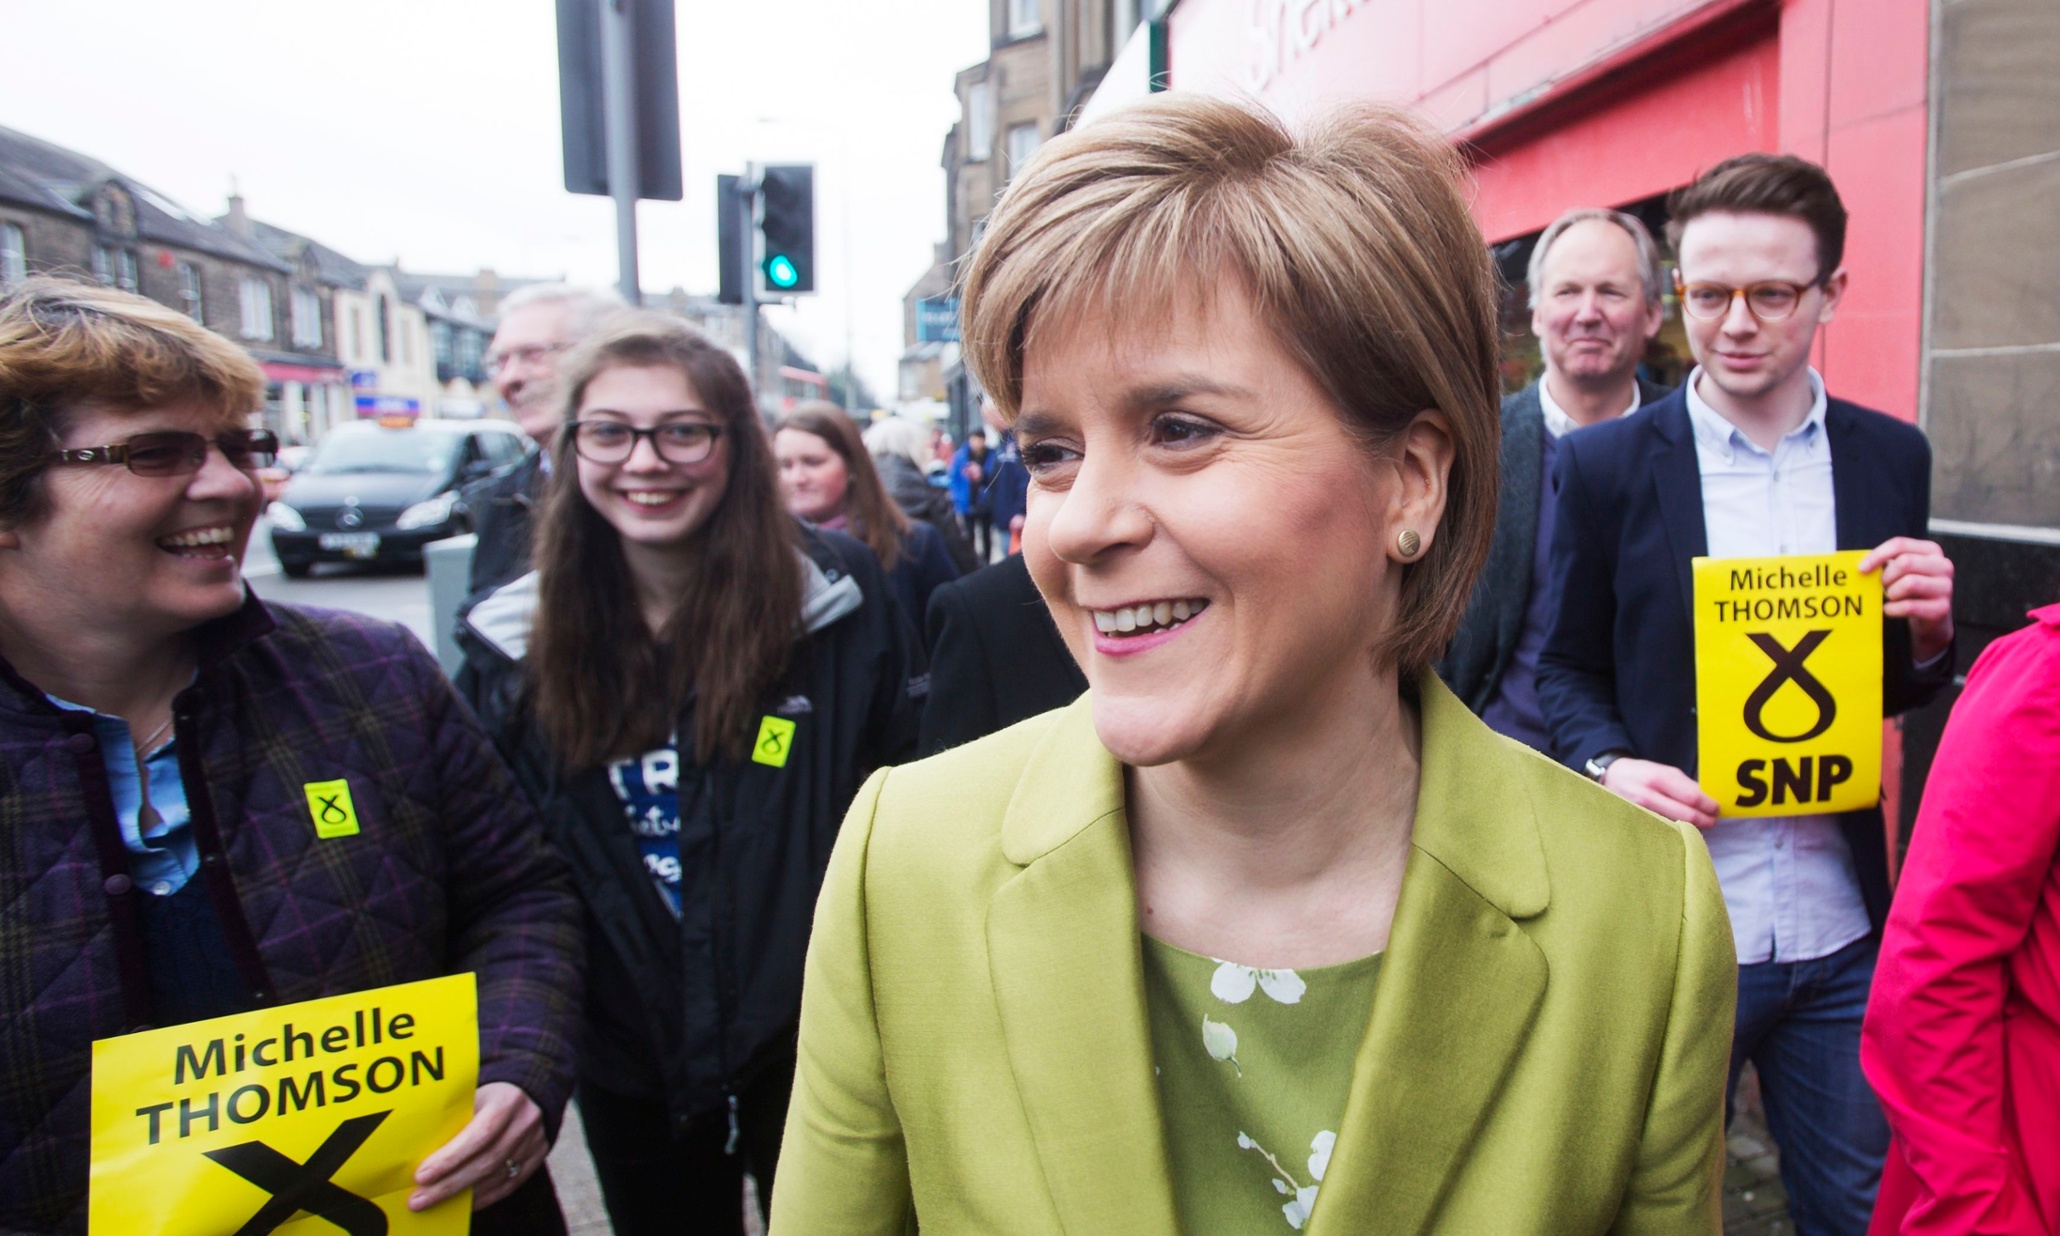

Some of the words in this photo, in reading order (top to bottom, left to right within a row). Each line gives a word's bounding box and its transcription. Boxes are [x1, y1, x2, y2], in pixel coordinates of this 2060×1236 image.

[1729, 564, 1848, 592] Michelle
[1713, 594, 1864, 623] THOMSON
[1734, 754, 1854, 808] SNP
[173, 1006, 415, 1086] Michelle
[135, 1045, 446, 1146] THOMSON
